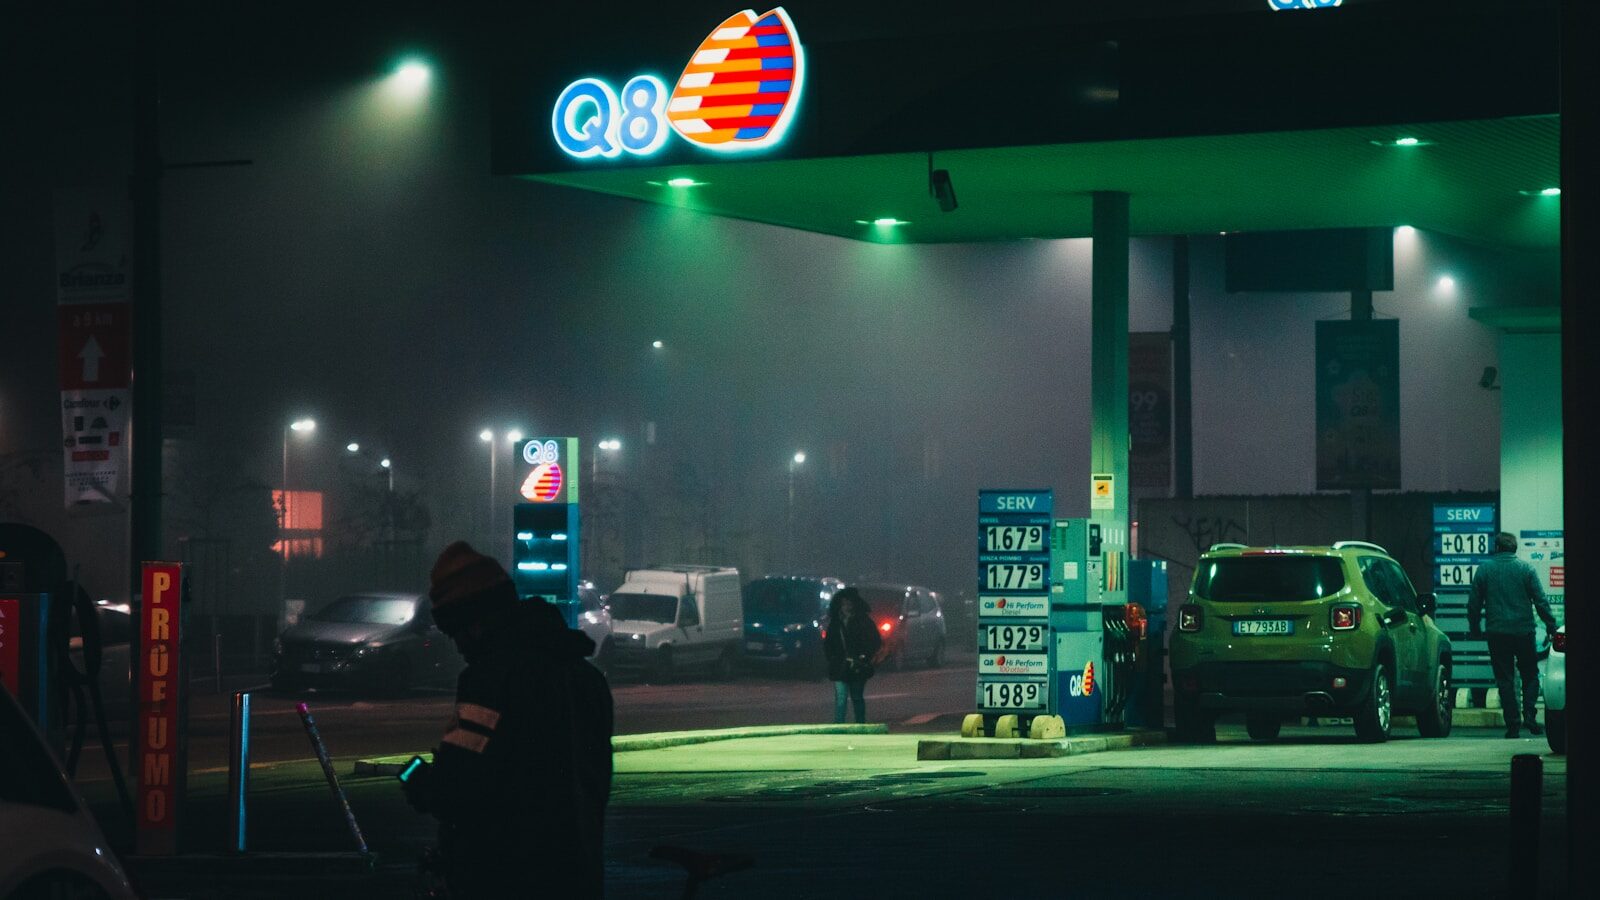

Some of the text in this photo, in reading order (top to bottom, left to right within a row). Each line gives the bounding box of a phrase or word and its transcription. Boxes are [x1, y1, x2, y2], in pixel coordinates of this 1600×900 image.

[552, 75, 669, 158] Q8
[523, 439, 559, 464] Q8
[997, 496, 1037, 510] SERV
[1447, 509, 1481, 520] SERV
[984, 601, 1044, 610] Q8 Hi Perform
[1240, 621, 1252, 632] EY
[1005, 659, 1014, 667] Hi
[1015, 659, 1043, 667] Perform
[1070, 674, 1081, 697] Q8
[144, 571, 171, 823] PROFUMO
